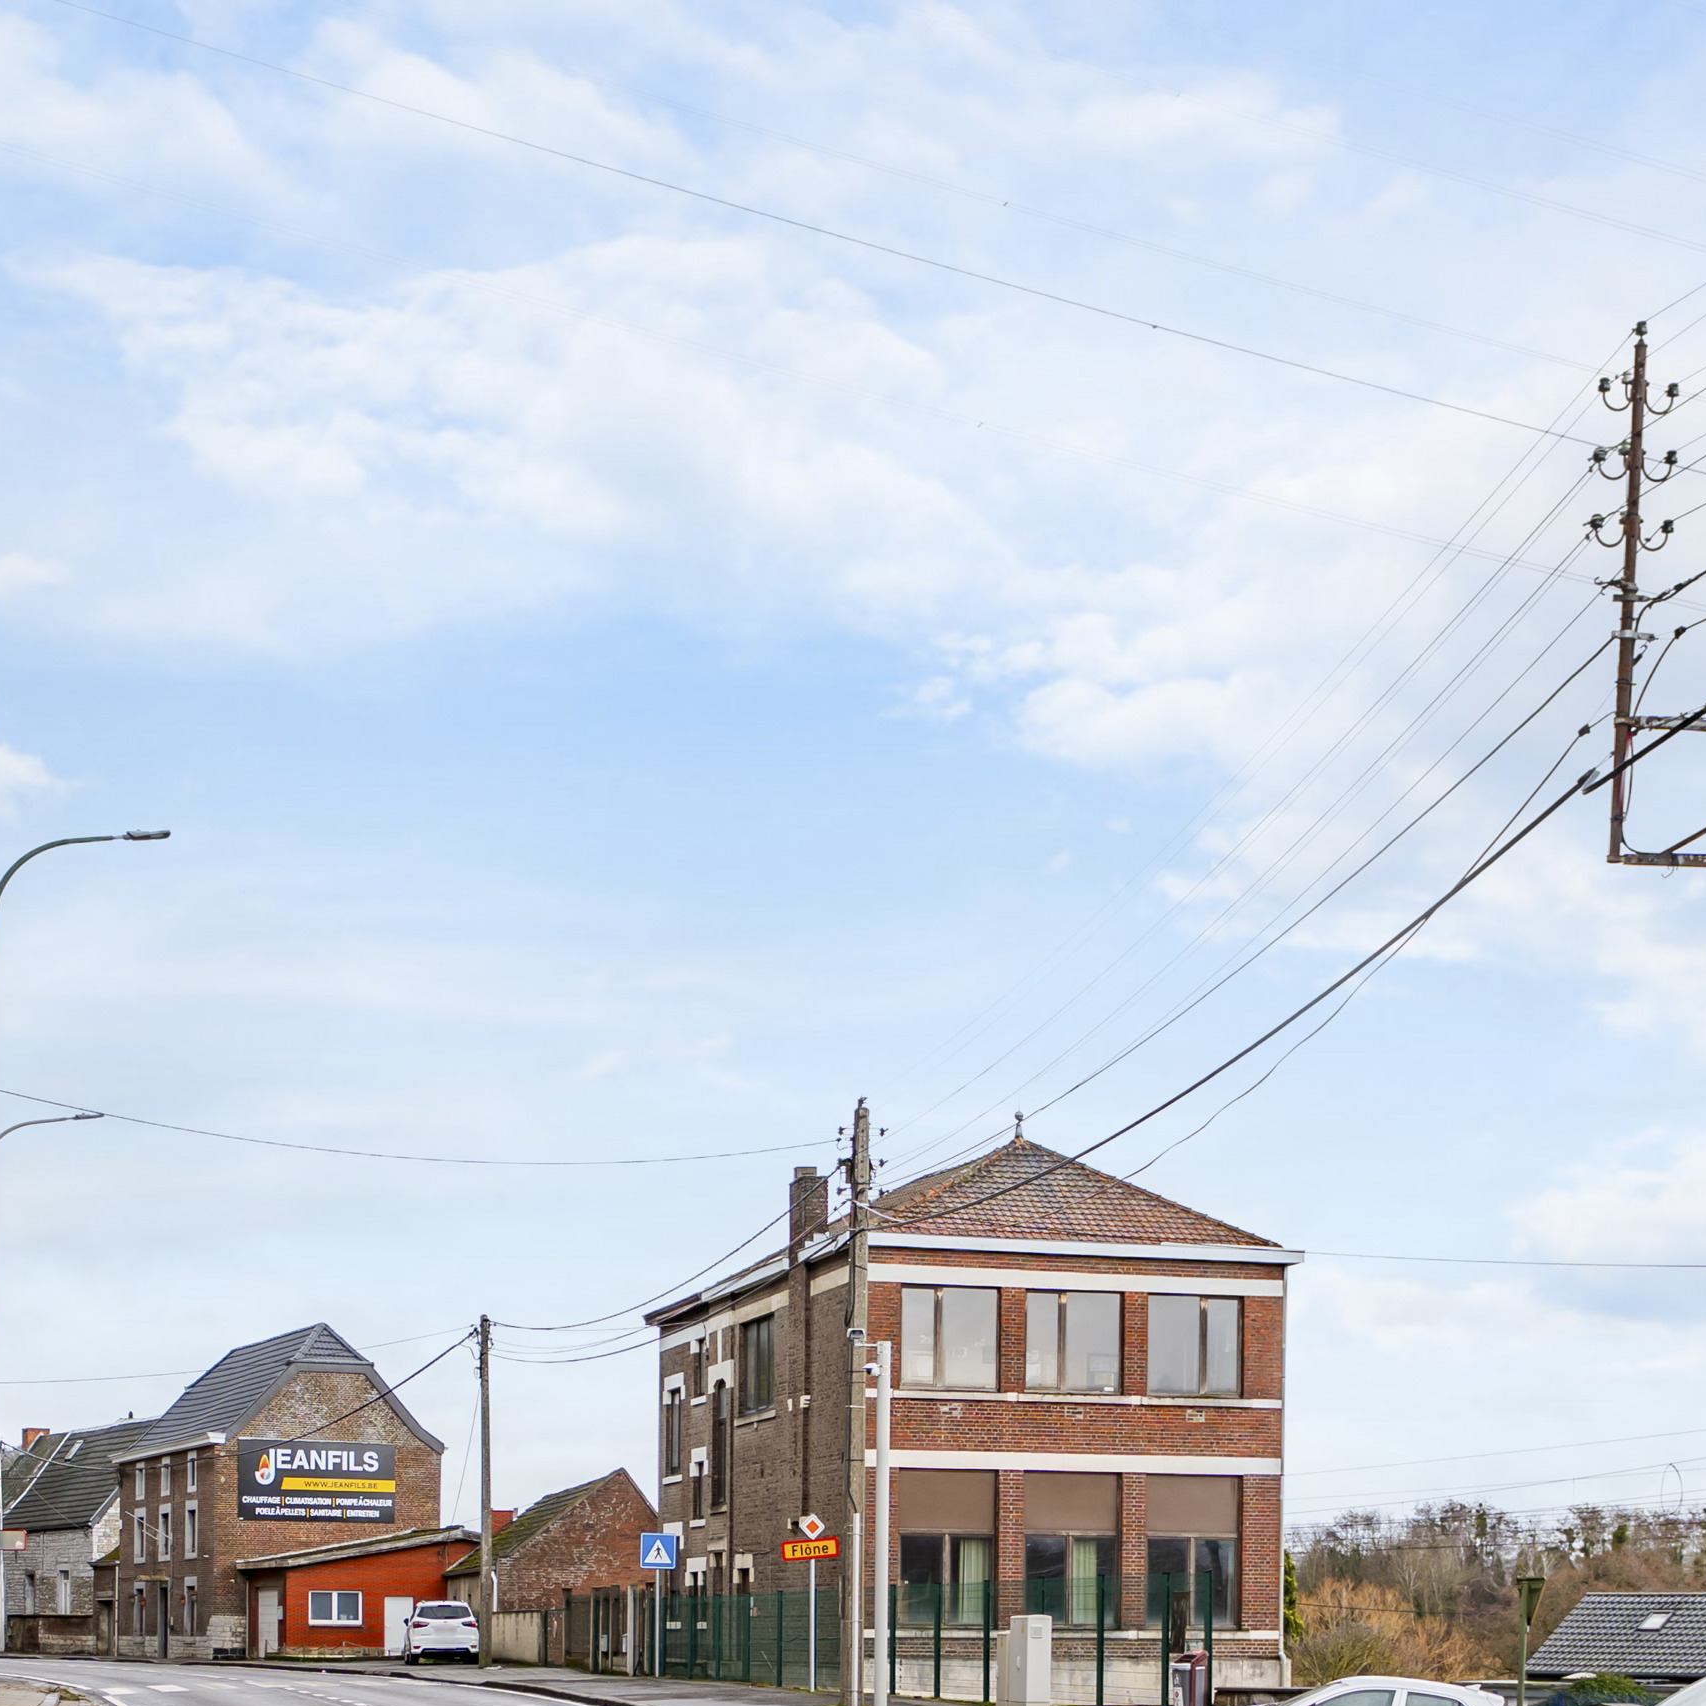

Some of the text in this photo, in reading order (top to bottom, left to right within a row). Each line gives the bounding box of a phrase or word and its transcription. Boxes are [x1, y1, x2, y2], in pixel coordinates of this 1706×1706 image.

[254, 1448, 379, 1486] JEANFILS
[304, 1481, 378, 1489] WWW.JEANFILS.BE
[241, 1495, 281, 1504] CHAUFFAGE
[285, 1496, 332, 1505] CLIMATISATION
[310, 1508, 343, 1517] SANITAIRE
[346, 1509, 380, 1518] ENTRETIEN
[791, 1543, 829, 1557] Flône
